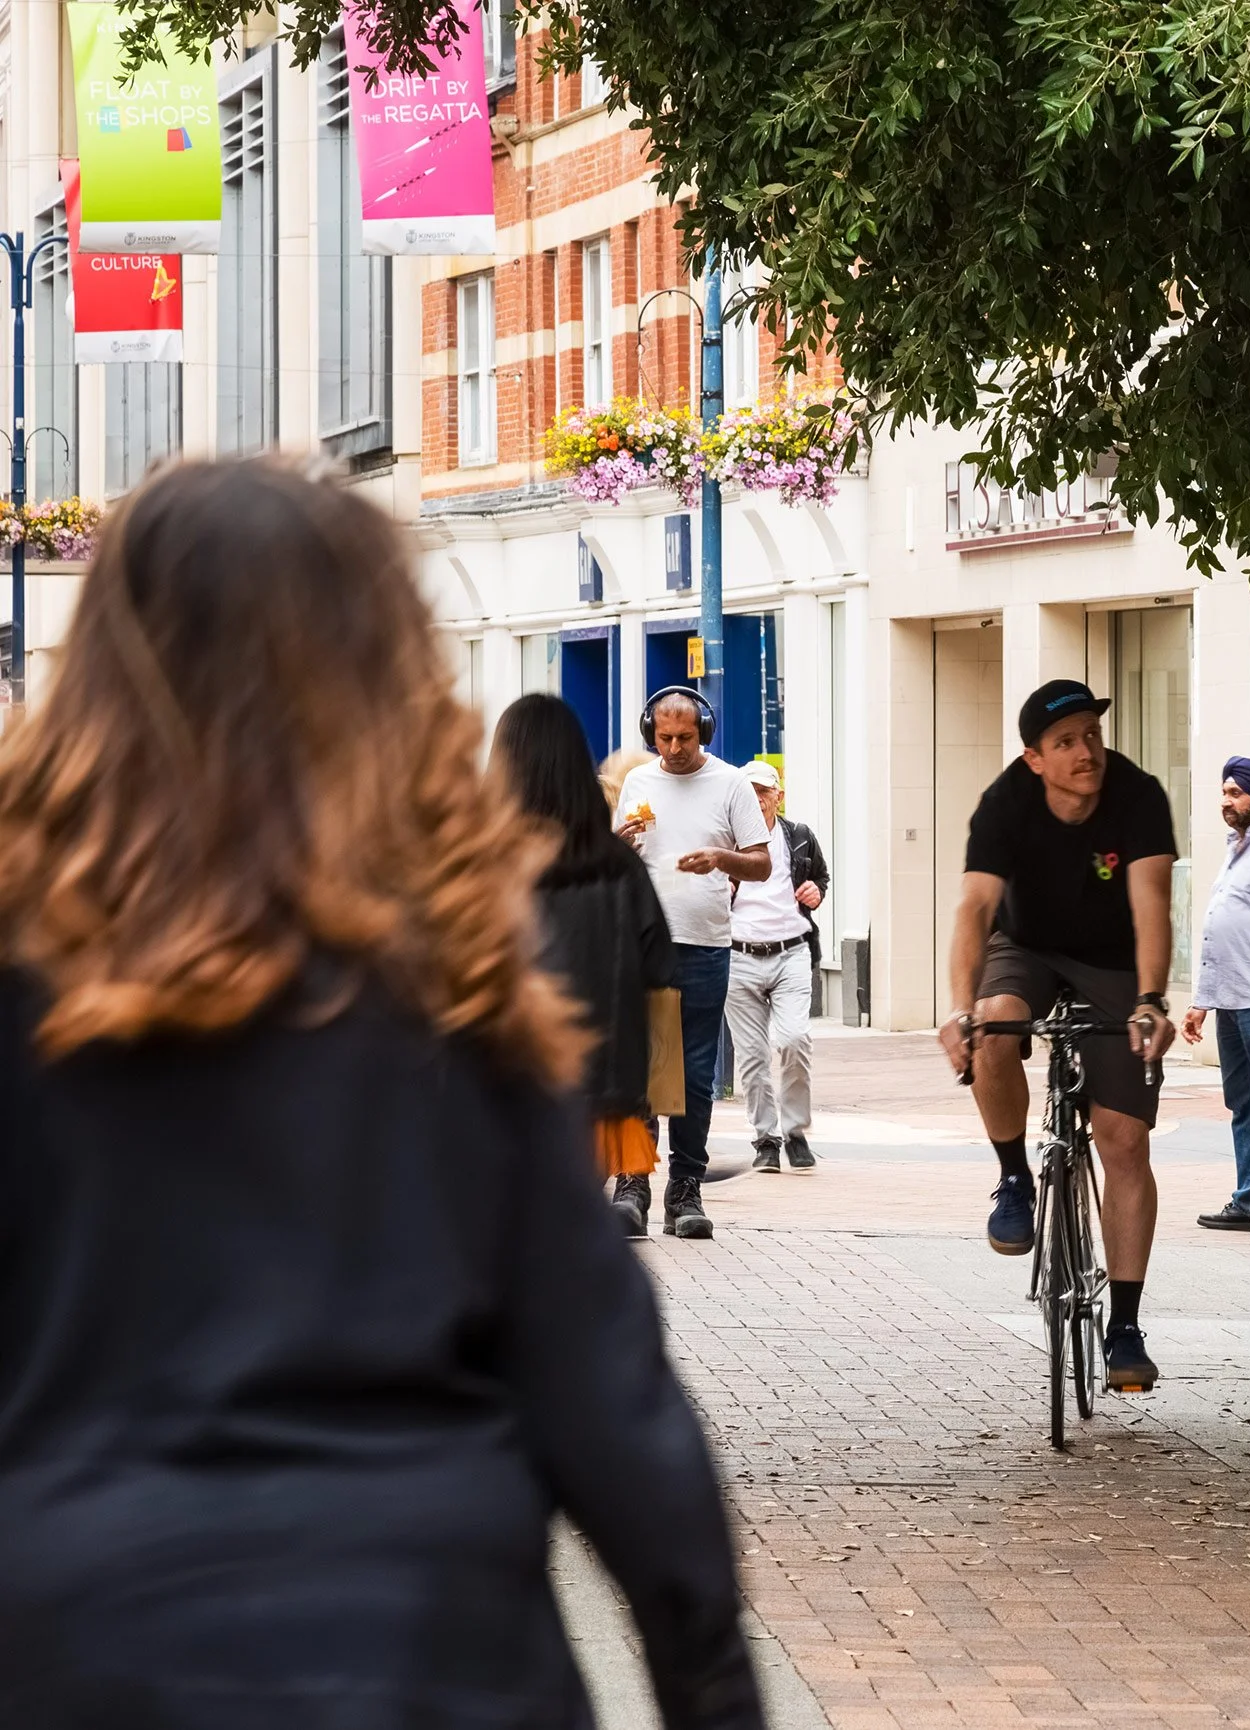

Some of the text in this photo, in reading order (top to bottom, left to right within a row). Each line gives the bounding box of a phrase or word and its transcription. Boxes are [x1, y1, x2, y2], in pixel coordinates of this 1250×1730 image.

[89, 80, 202, 100] FLOAT BY
[371, 76, 469, 98] DRIFT BY
[86, 106, 212, 126] THE SHOPS
[361, 102, 483, 124] THE REGATTA
[91, 256, 162, 271] CULTURE
